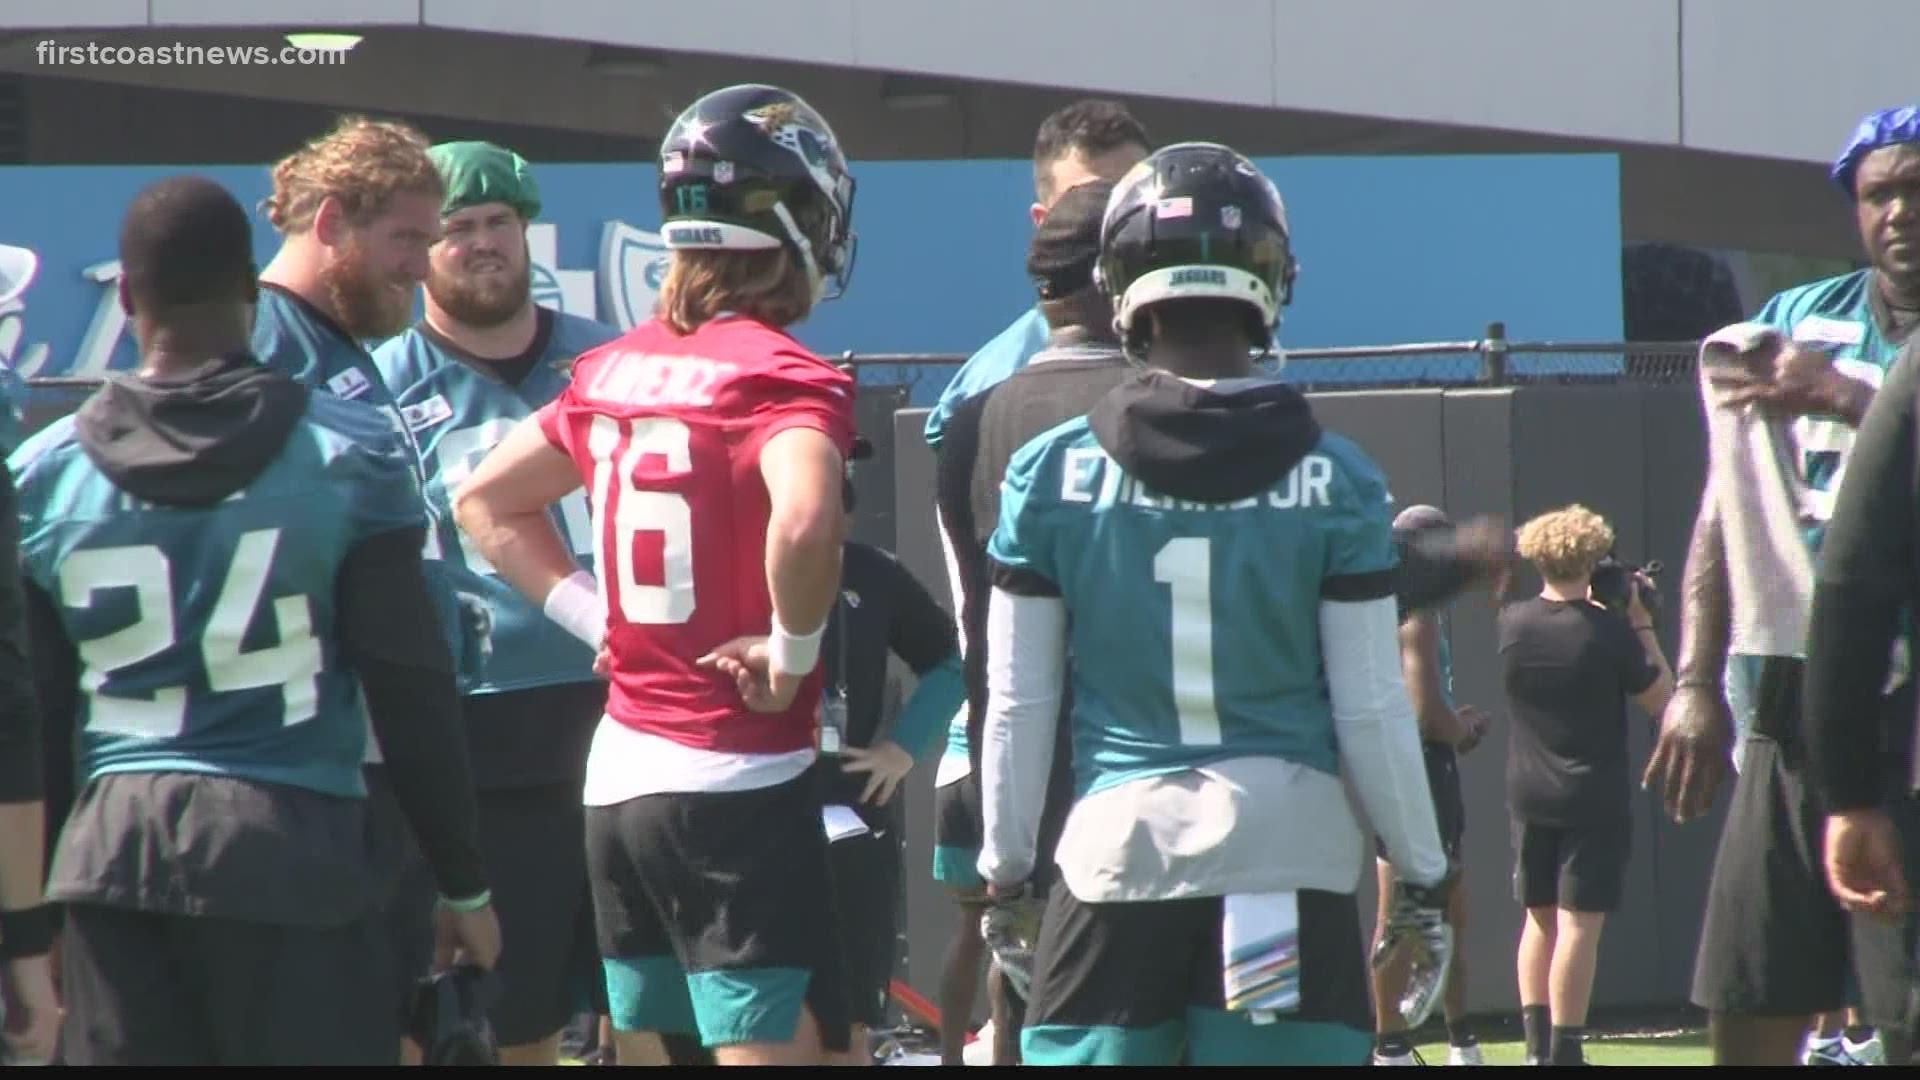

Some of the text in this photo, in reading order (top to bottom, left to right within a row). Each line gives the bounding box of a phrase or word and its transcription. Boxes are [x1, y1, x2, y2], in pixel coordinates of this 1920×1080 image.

[588, 413, 697, 625] 16
[58, 528, 324, 737] 24
[1154, 536, 1222, 745] 1
